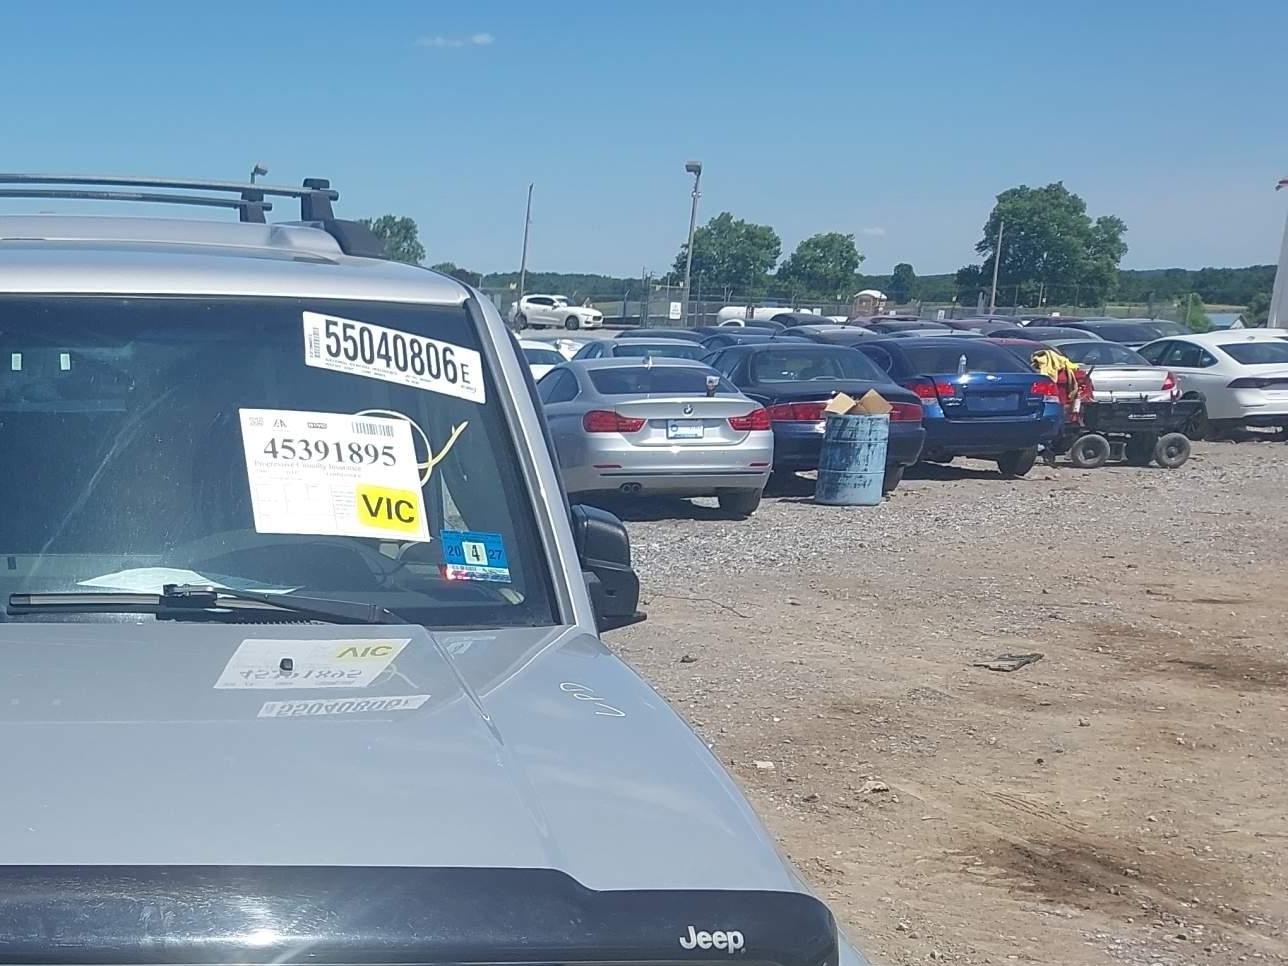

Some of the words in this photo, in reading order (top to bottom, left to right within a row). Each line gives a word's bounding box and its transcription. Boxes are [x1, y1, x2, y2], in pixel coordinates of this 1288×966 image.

[324, 319, 458, 385] 55040806
[461, 362, 472, 385] E
[263, 437, 397, 467] 45391895
[362, 493, 415, 524] VIC
[447, 544, 462, 557] 20
[471, 544, 481, 562] 4
[488, 549, 503, 561] 27
[679, 925, 745, 954] Jeep
